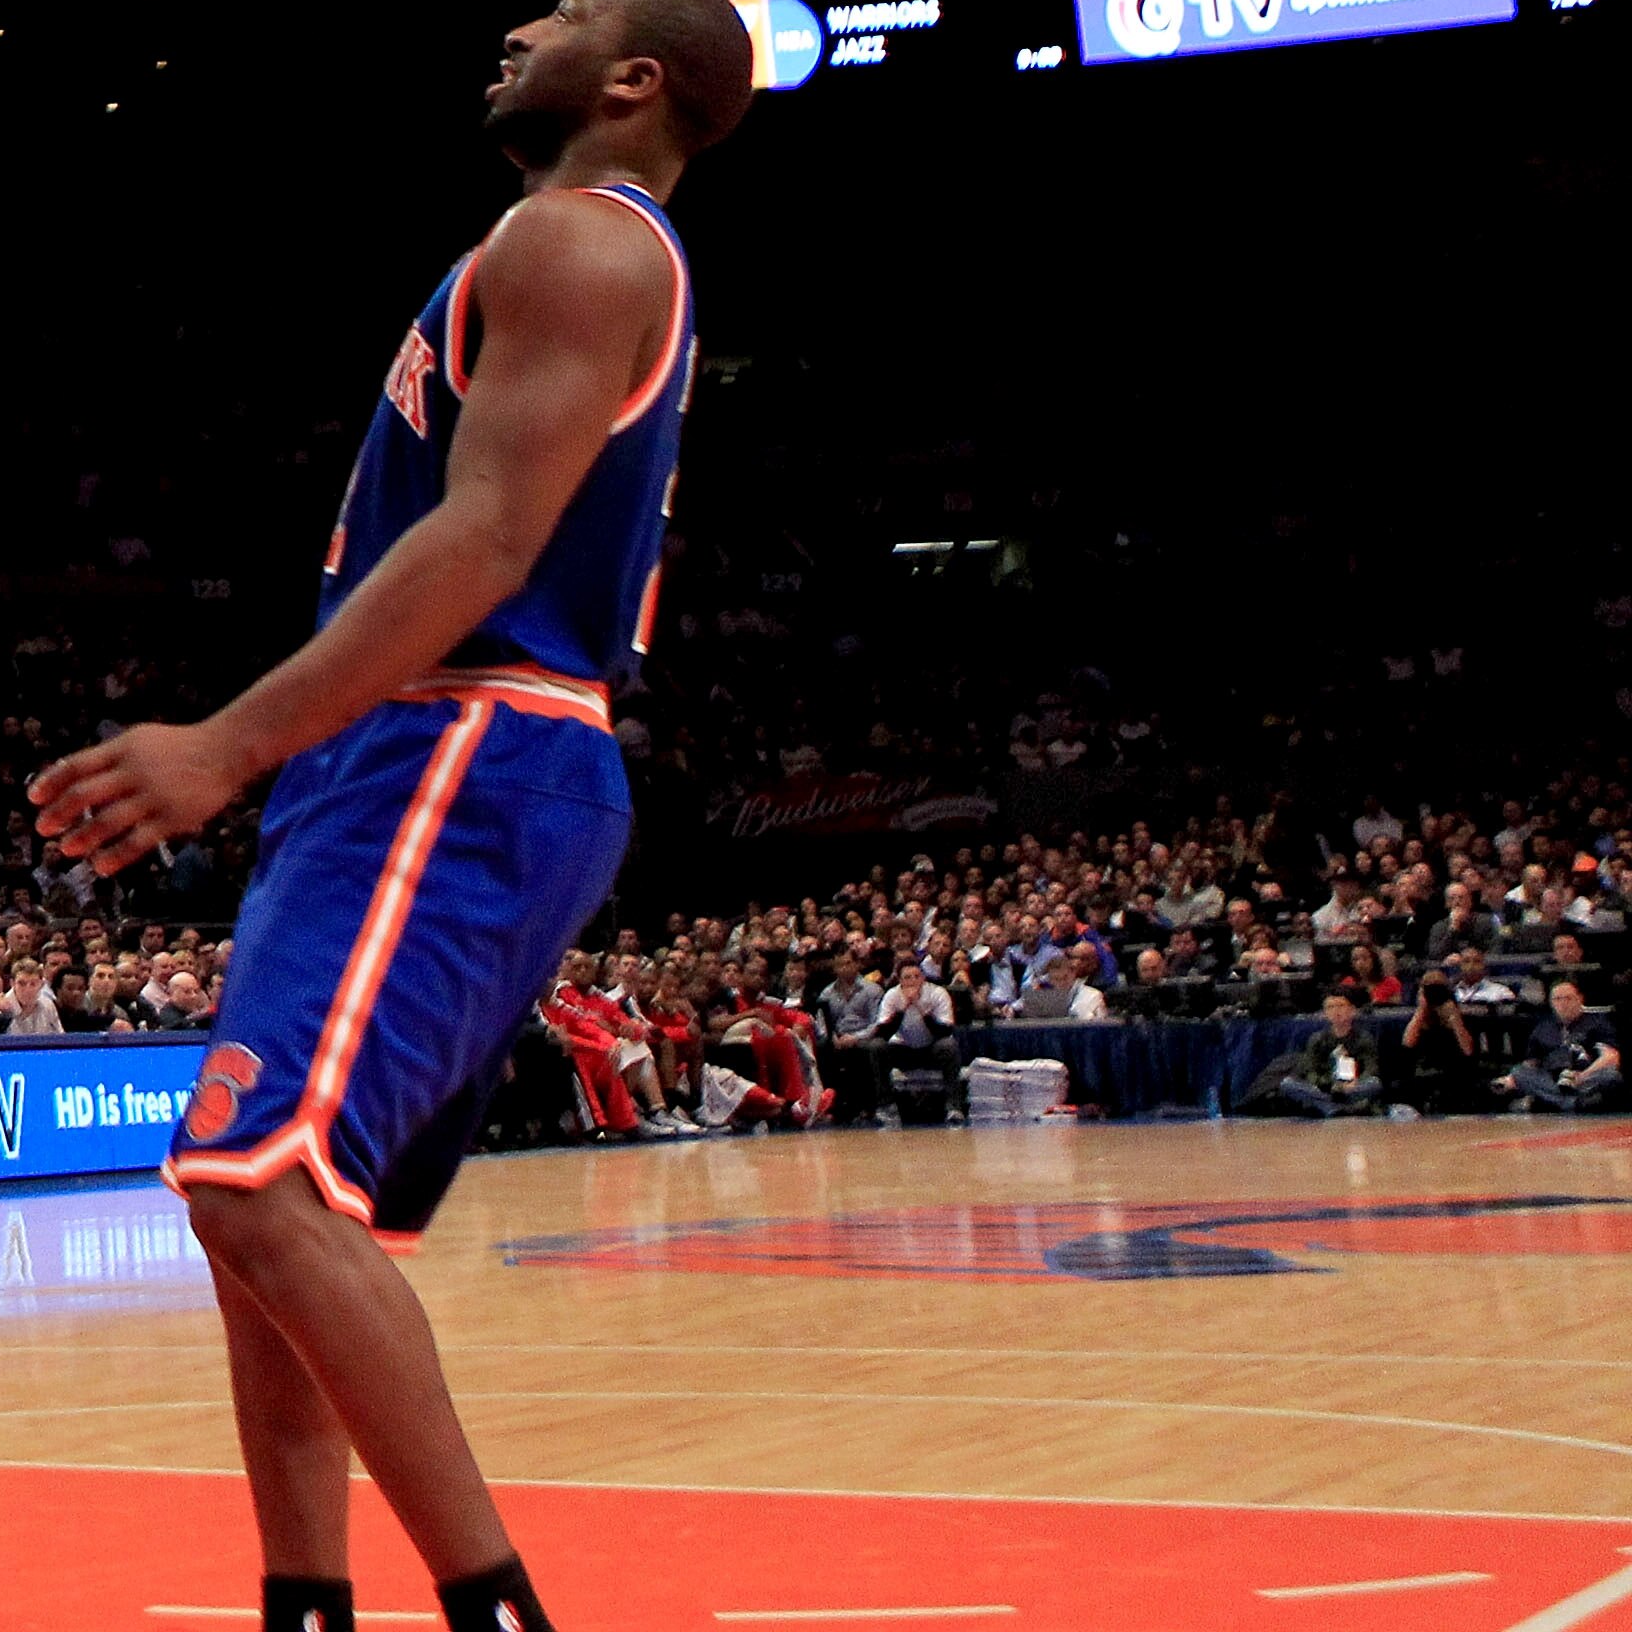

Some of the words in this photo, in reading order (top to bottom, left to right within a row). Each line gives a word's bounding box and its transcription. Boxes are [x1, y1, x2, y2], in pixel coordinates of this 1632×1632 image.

[774, 29, 815, 53] NBA
[830, 35, 886, 66] JAZZ
[190, 577, 233, 602] 128
[760, 570, 804, 594] 129
[54, 1085, 95, 1130] HD
[97, 1081, 121, 1126] is
[123, 1081, 173, 1125] free
